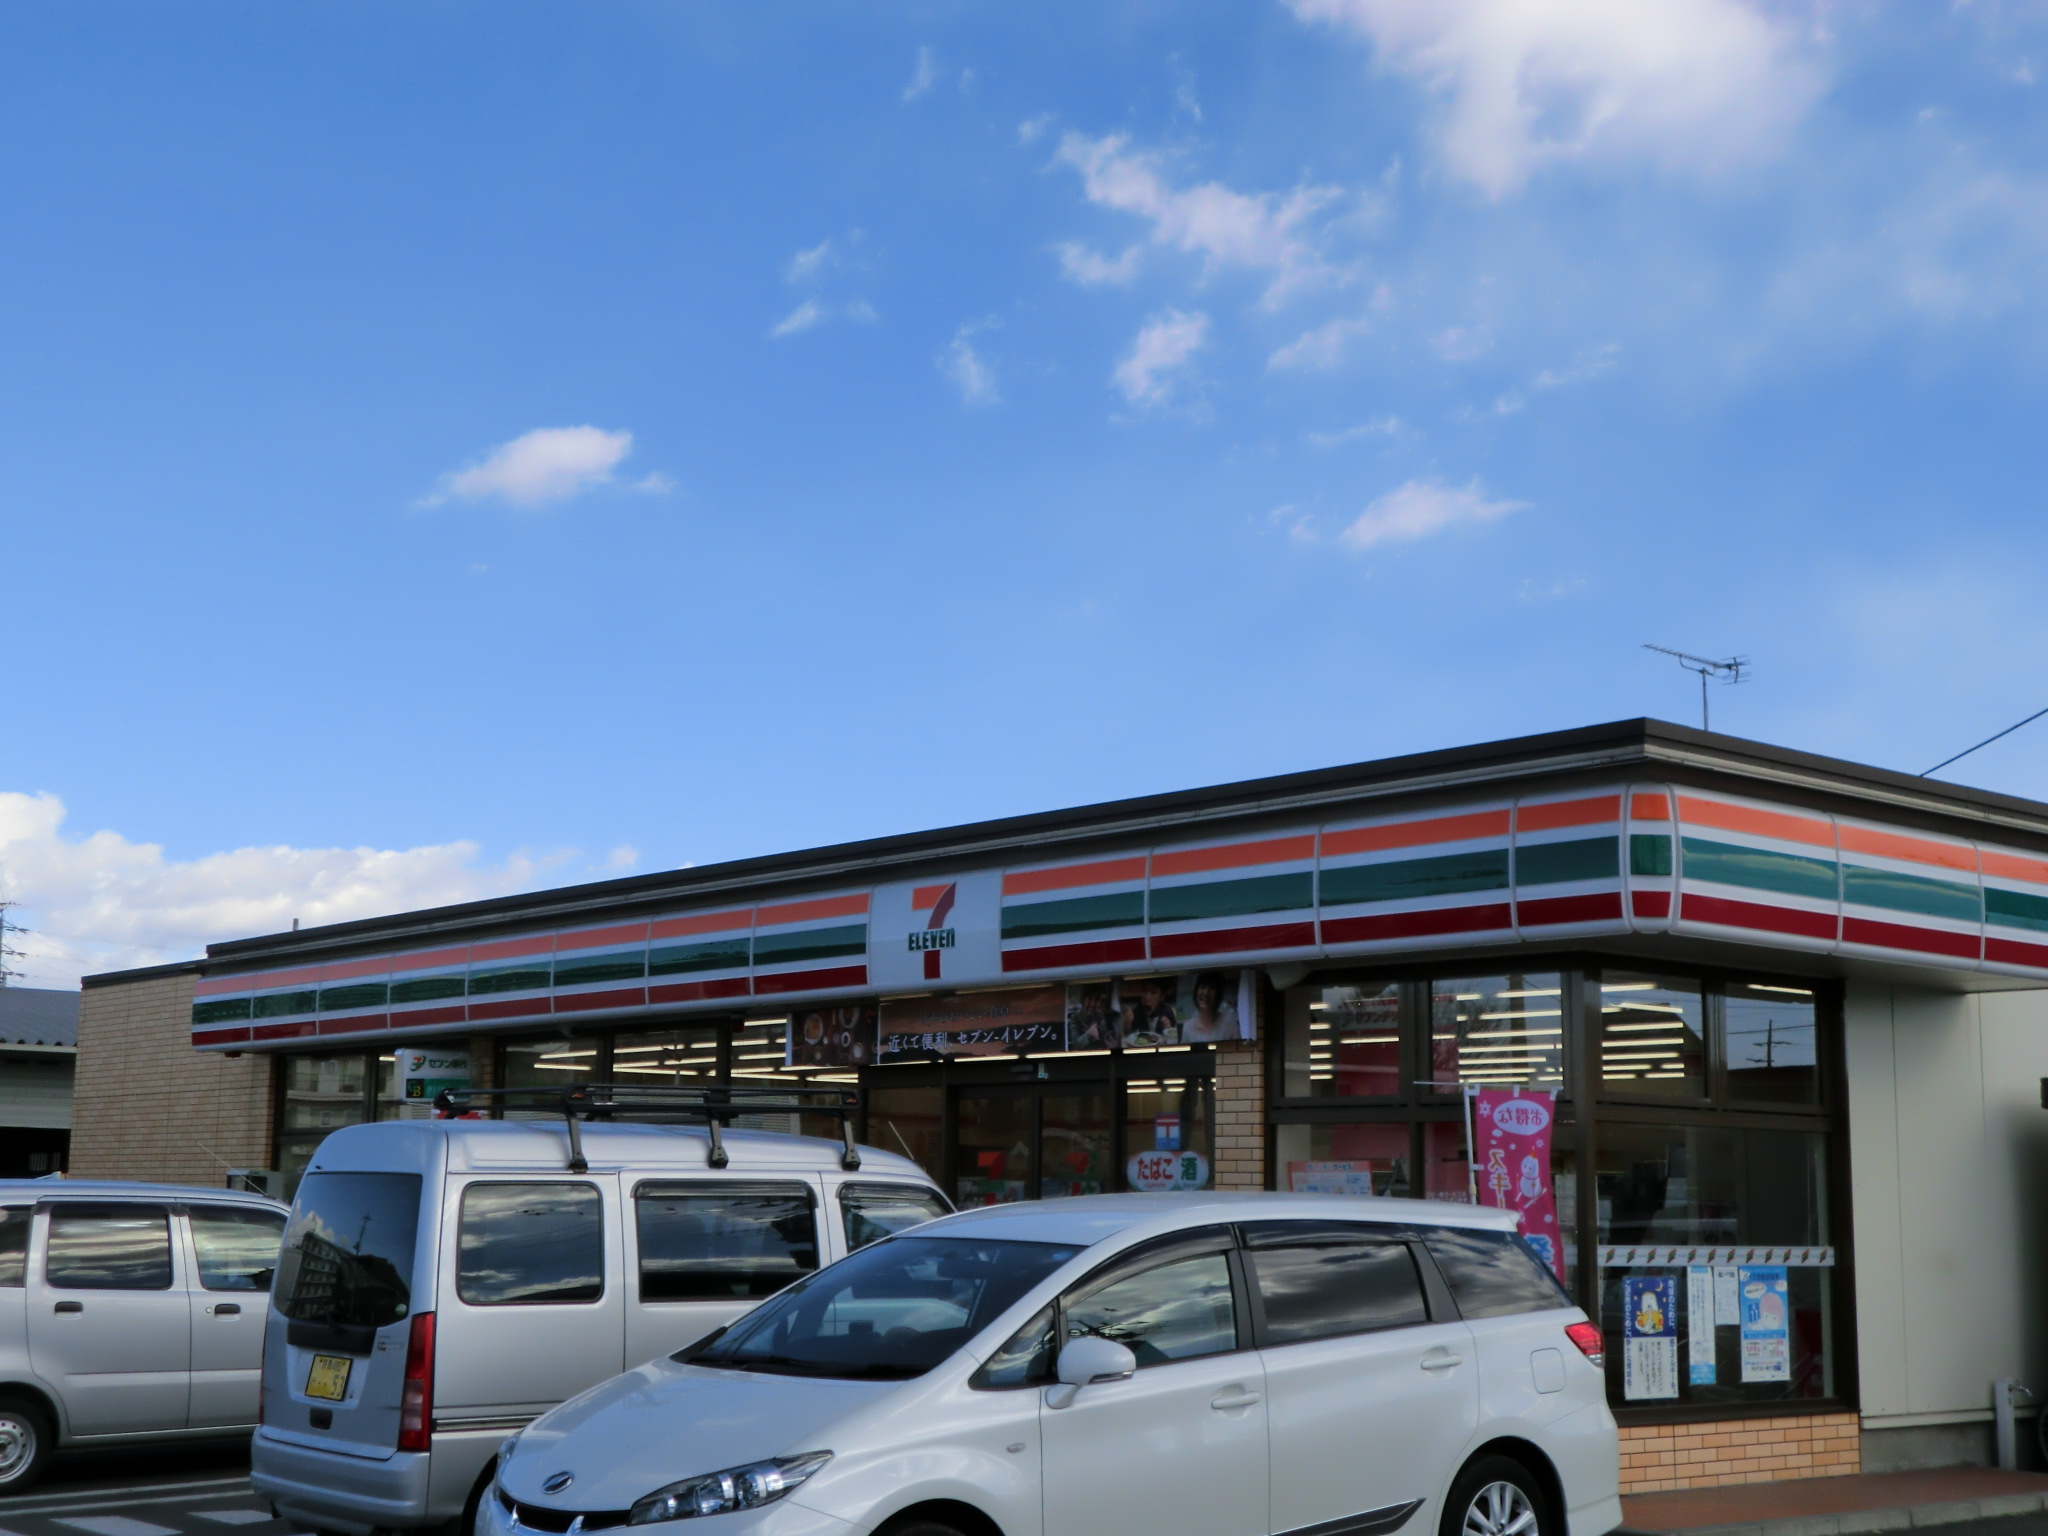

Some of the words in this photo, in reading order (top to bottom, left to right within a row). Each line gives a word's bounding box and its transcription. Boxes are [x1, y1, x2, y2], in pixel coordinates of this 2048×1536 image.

[911, 881, 956, 979] 7
[1137, 1157, 1174, 1180] たばこ
[1181, 1157, 1198, 1181] 酒
